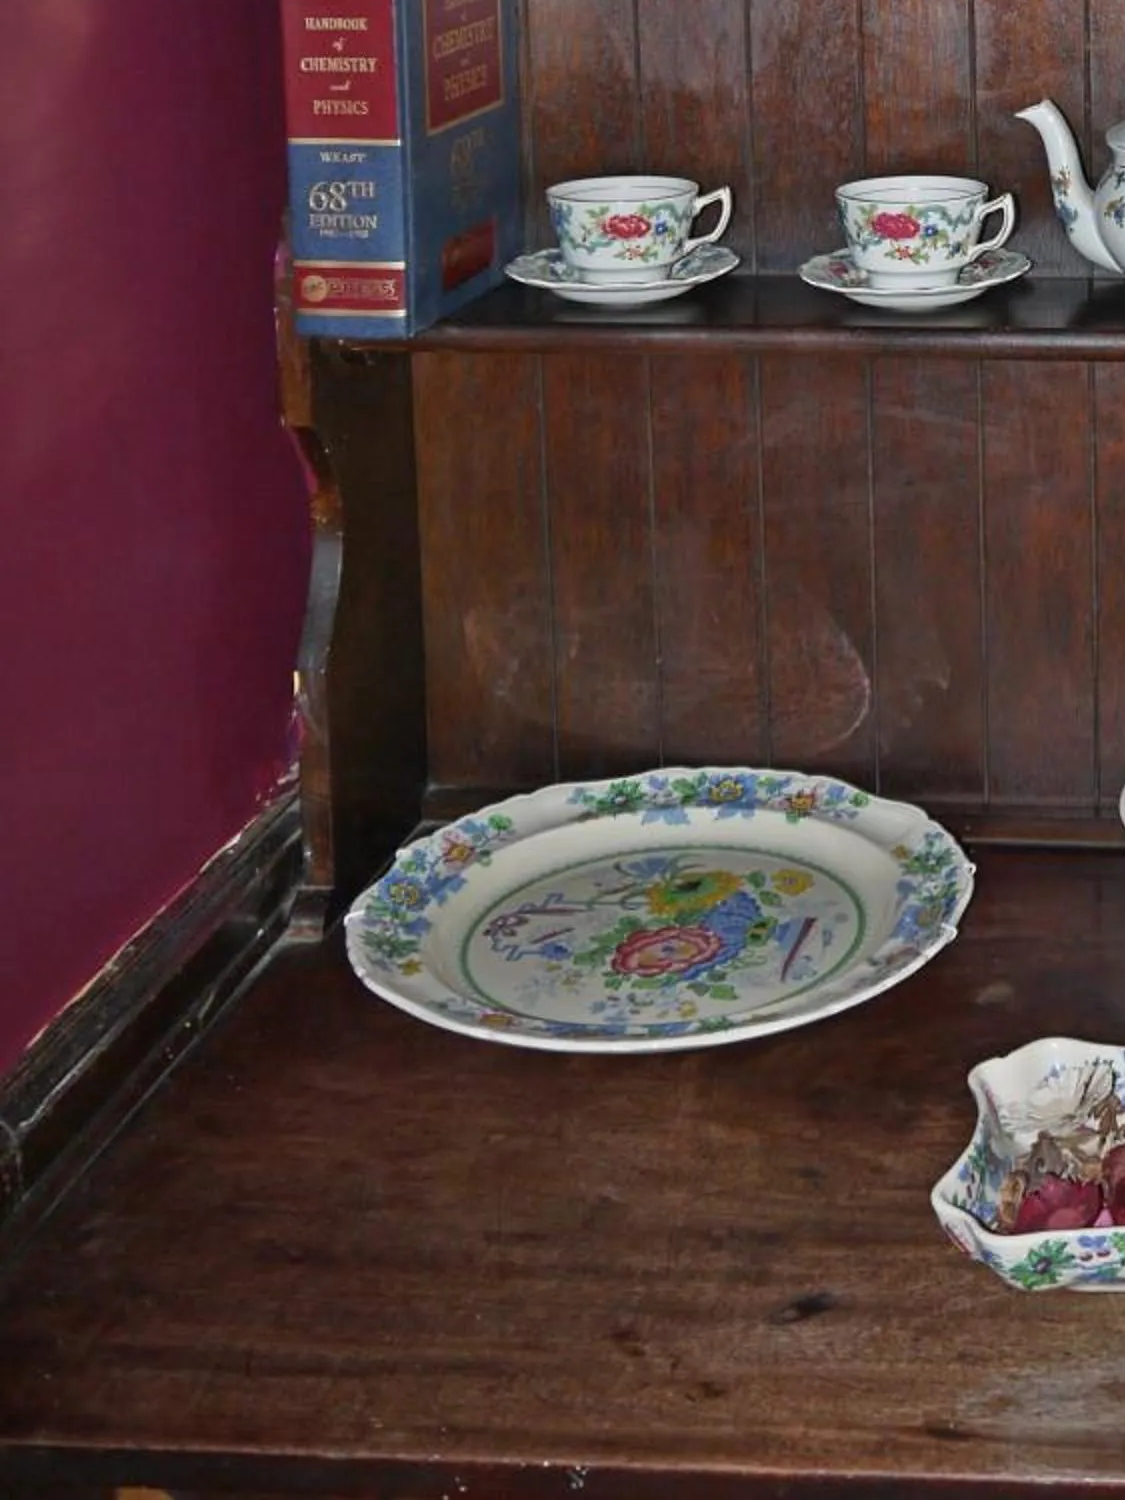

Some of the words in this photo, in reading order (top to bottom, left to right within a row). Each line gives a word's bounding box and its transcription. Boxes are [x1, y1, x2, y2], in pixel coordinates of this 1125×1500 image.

[304, 17, 368, 31] HANDBOOK
[300, 57, 378, 73] CHEMISTRY
[313, 99, 369, 115] PHYSICS
[309, 181, 375, 212] 68TH
[309, 213, 378, 229] EDITION
